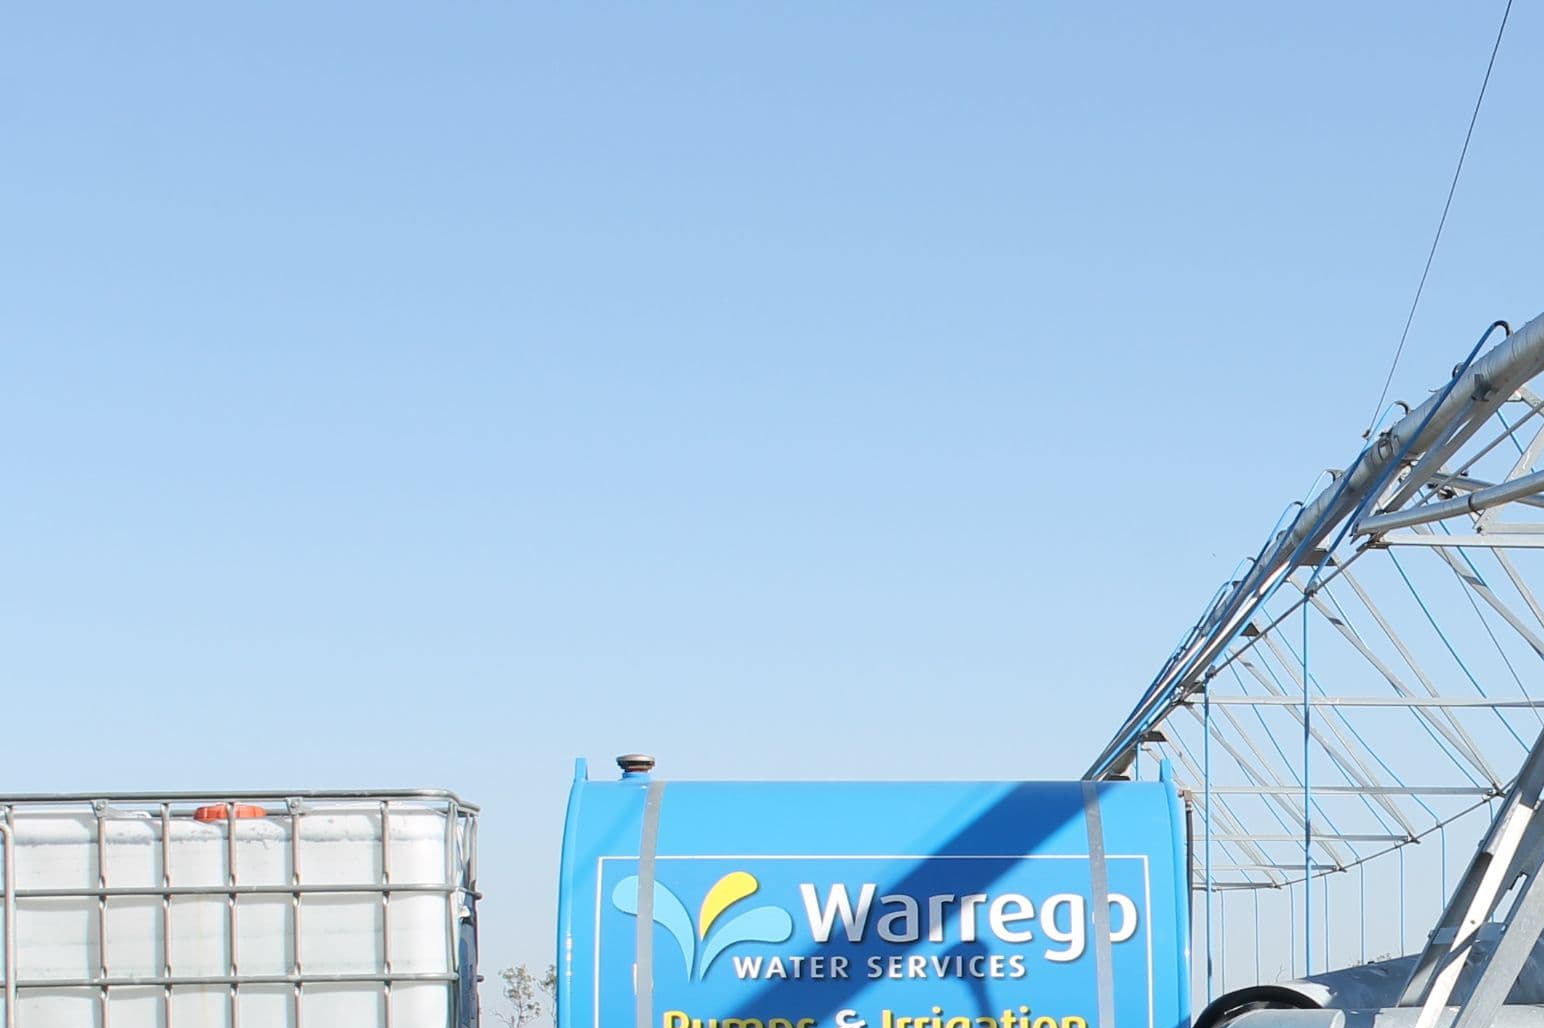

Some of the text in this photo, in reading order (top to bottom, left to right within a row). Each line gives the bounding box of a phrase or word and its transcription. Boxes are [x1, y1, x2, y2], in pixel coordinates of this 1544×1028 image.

[799, 883, 1138, 963] Warrego
[733, 955, 1025, 979] WATER SERVICES
